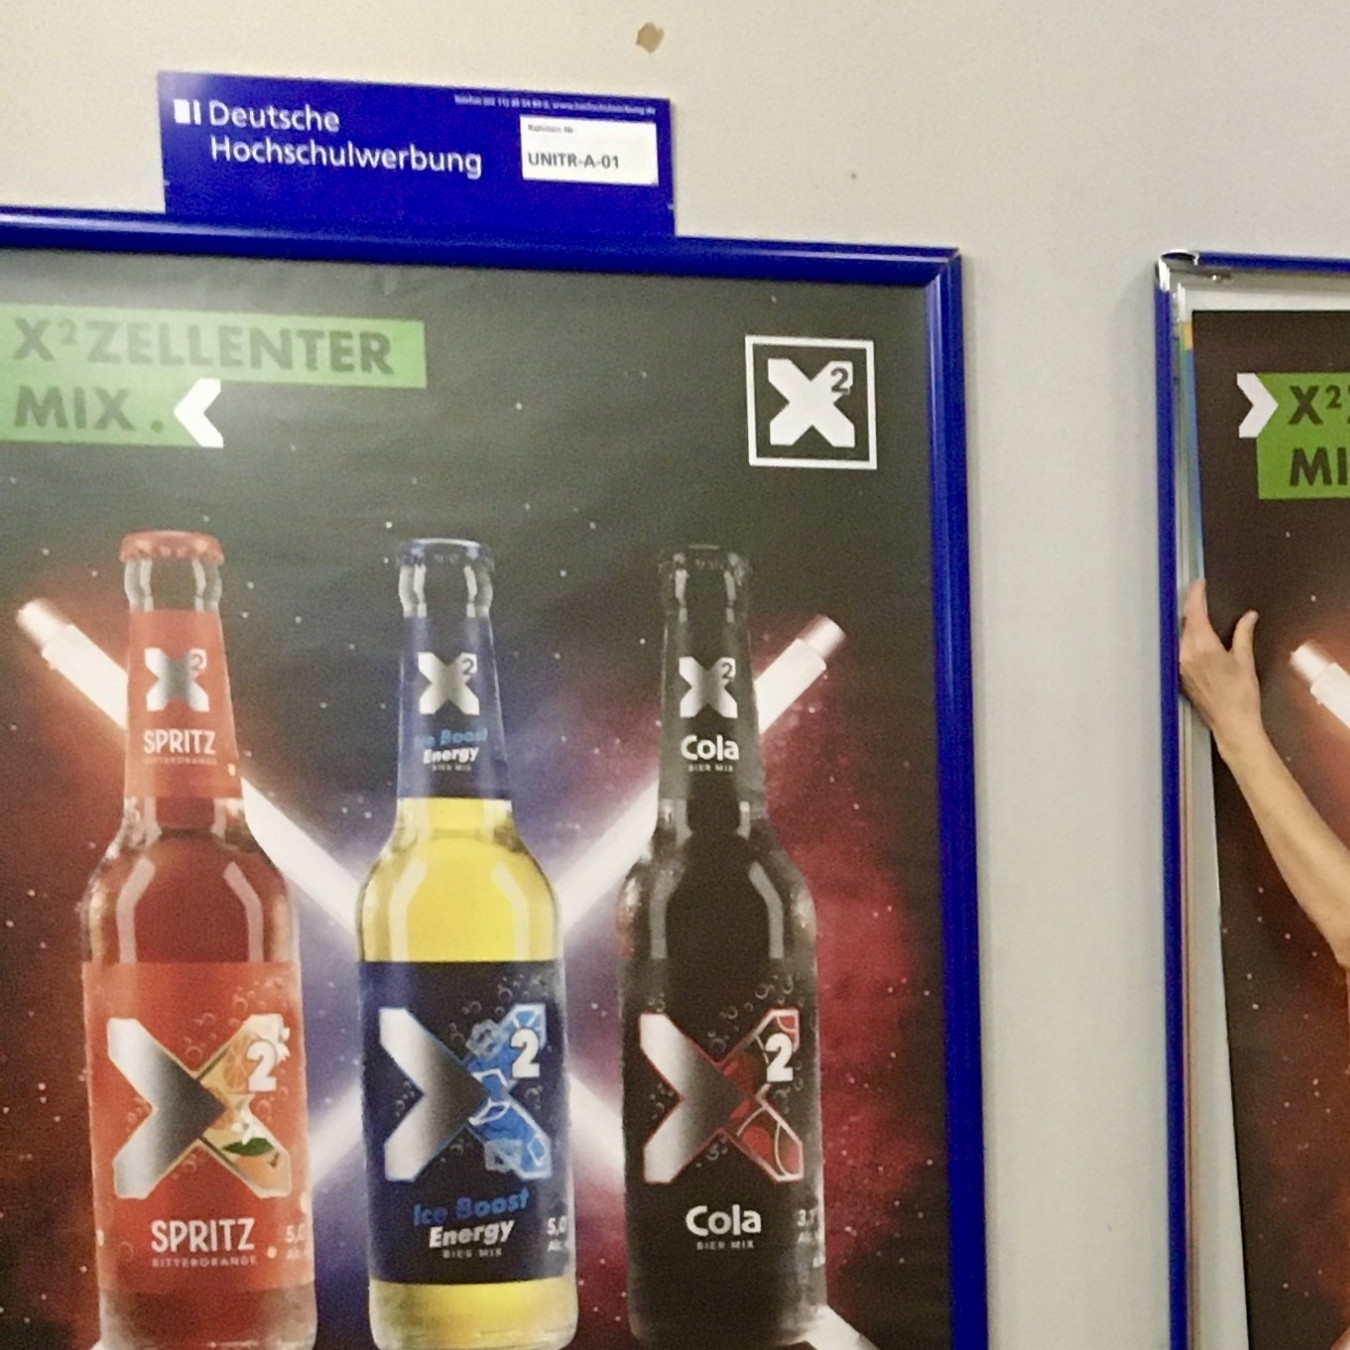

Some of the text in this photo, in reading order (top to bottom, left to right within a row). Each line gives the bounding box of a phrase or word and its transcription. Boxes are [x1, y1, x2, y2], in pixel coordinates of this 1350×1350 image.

[207, 100, 341, 132] Deutsche
[209, 134, 483, 180] Hochschulwerbung
[527, 151, 620, 170] UNITR-A-01
[143, 729, 217, 755] SPRITZ
[422, 746, 479, 764] Energy
[680, 734, 740, 761] Cola
[413, 1188, 530, 1226] Ice Boost
[685, 1204, 762, 1237] Cola
[151, 1217, 255, 1253] SPRITZ
[429, 1219, 516, 1248] Energy
